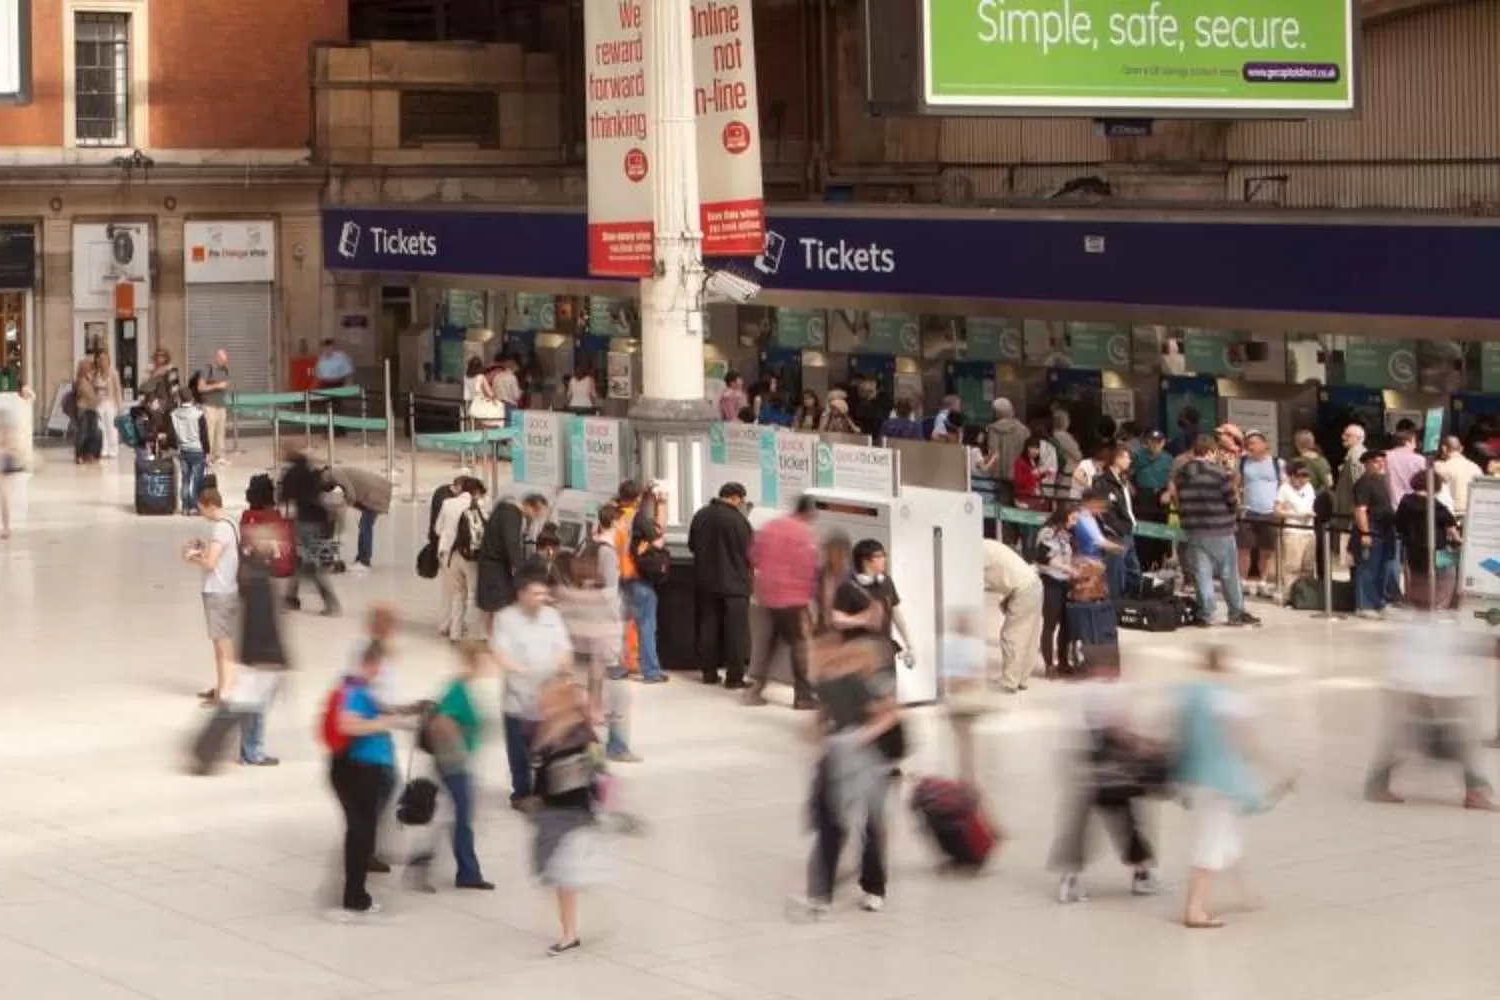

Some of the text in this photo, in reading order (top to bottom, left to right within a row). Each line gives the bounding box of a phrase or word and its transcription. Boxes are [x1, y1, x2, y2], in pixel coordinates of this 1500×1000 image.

[977, 0, 1307, 55] Simple, safe, secure.
[595, 34, 643, 66] reward
[713, 38, 743, 73] not
[589, 69, 645, 102] forward
[693, 78, 748, 118] n-line
[590, 108, 648, 141] thinking
[368, 226, 438, 257] Tickets
[799, 237, 896, 274] Tickets
[778, 453, 811, 474] ticket
